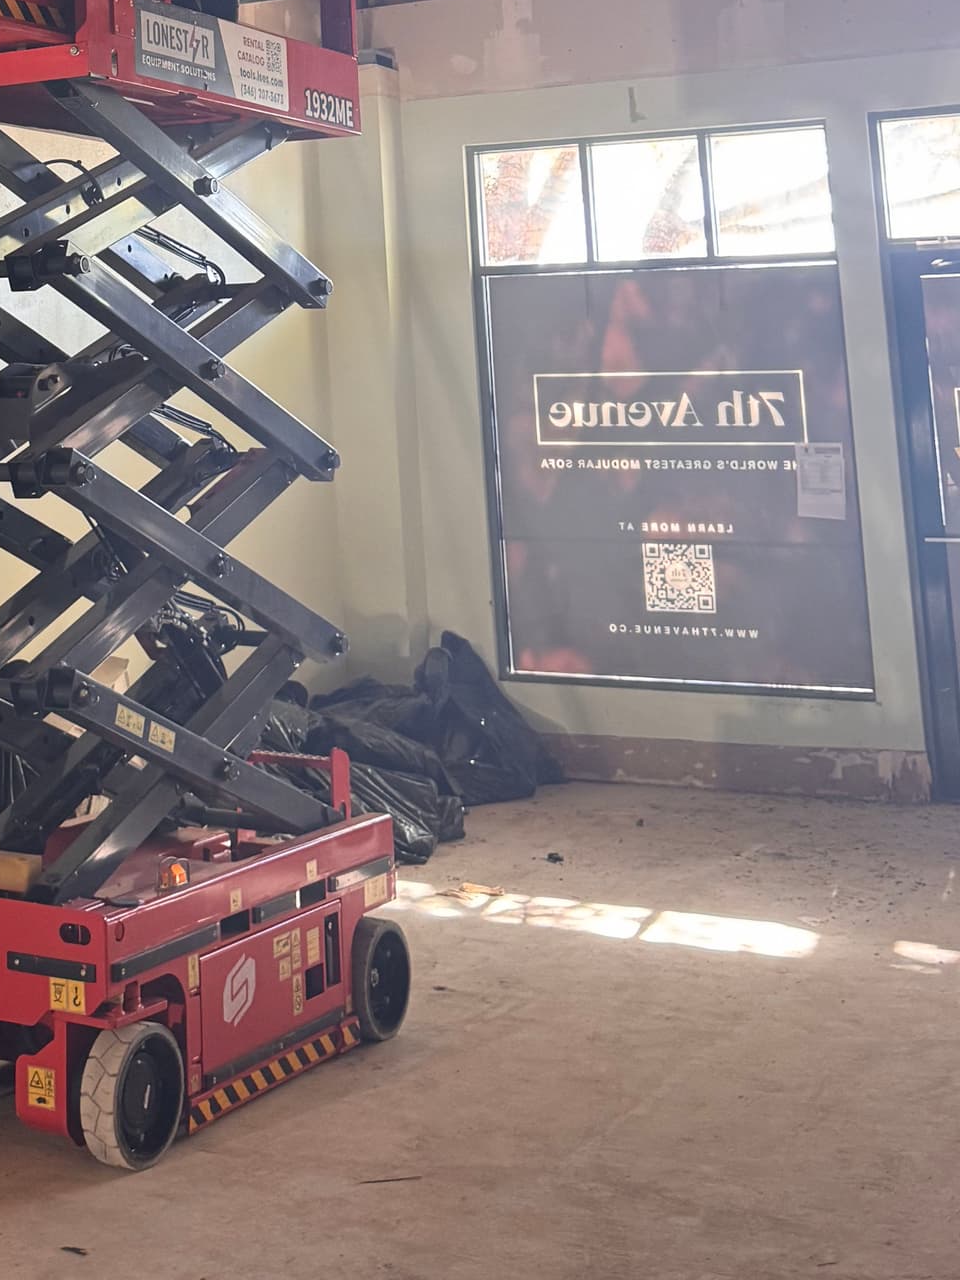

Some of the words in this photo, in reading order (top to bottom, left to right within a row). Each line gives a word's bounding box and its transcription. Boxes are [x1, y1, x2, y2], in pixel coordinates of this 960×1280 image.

[243, 36, 265, 51] RENTAL
[142, 54, 180, 73] EQUIPMENT
[180, 64, 217, 81] SOLUTIONS
[237, 50, 265, 66] CATALOG
[304, 88, 354, 128] 1932ME
